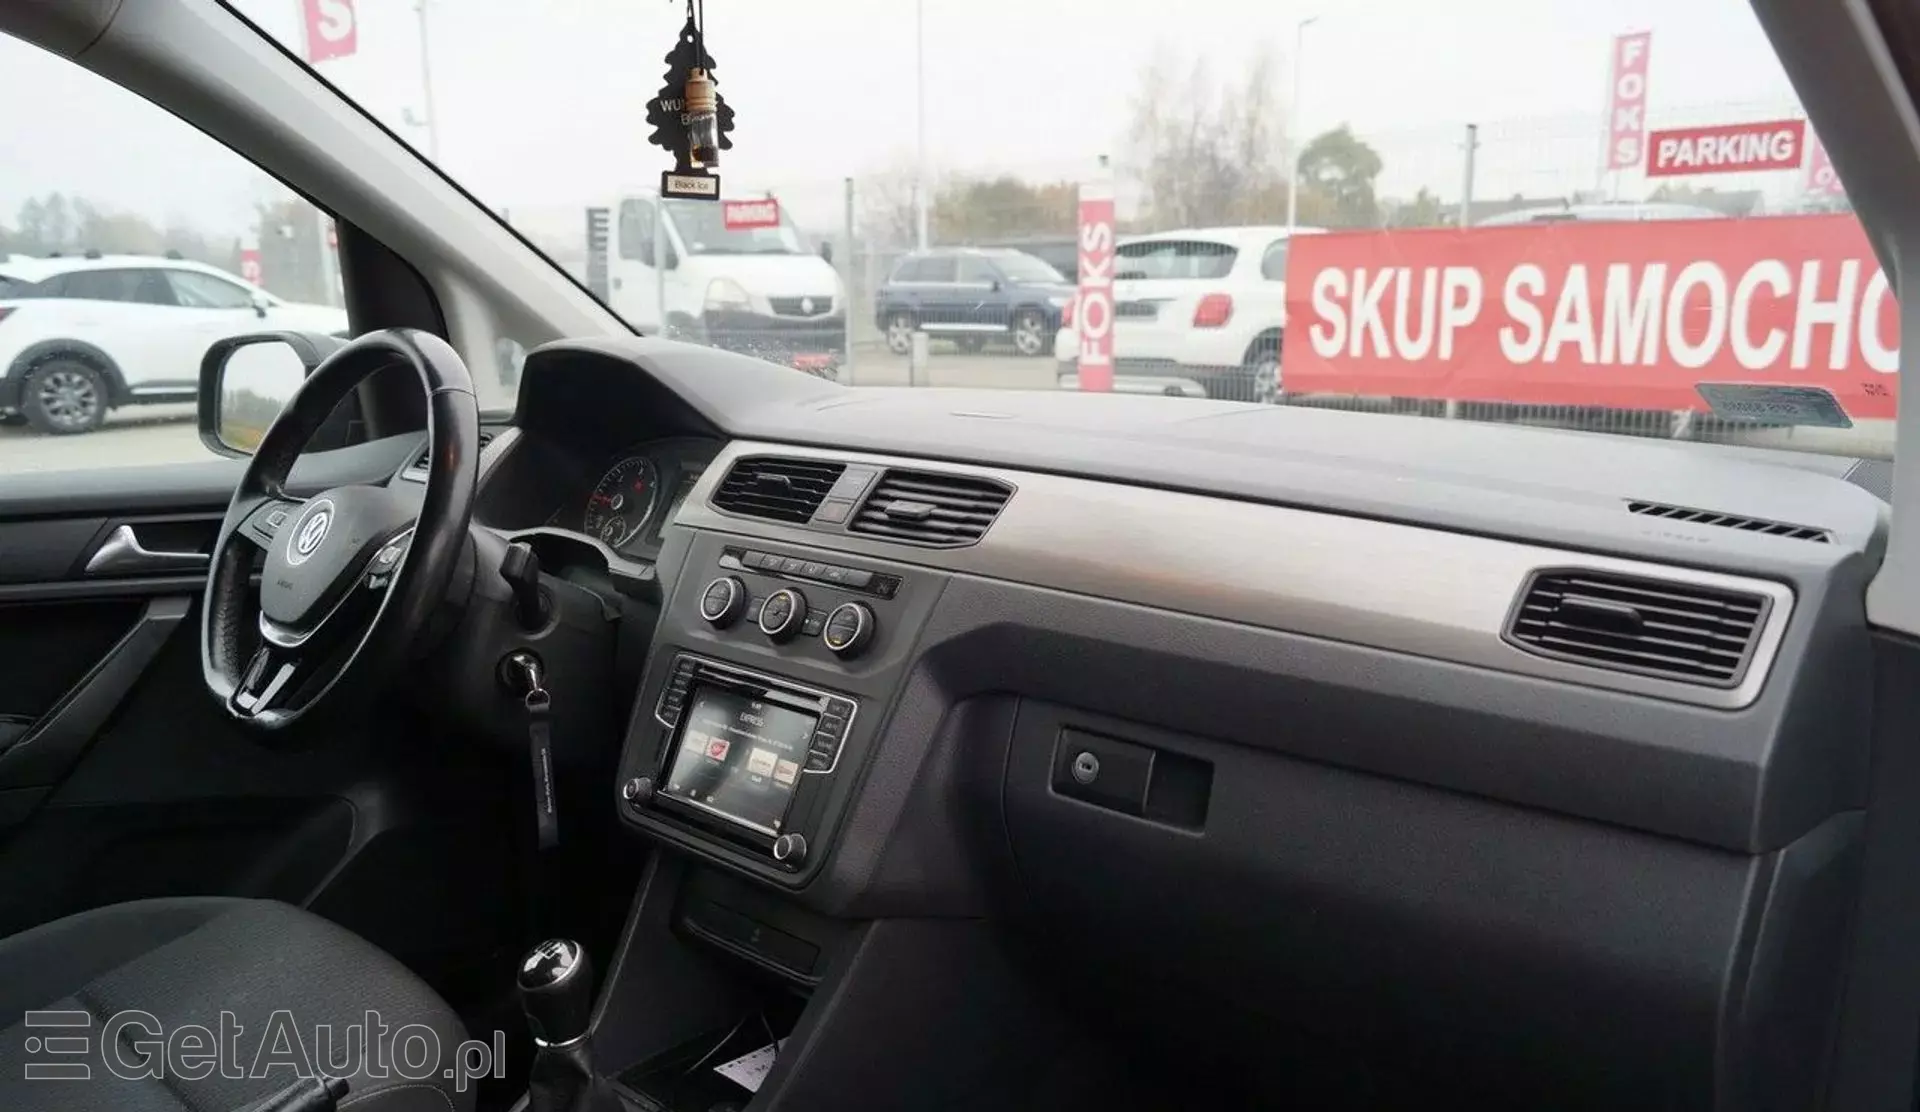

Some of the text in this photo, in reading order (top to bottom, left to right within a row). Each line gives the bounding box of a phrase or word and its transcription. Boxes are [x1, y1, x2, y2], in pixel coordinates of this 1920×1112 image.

[1615, 39, 1644, 165] FOKS
[1656, 130, 1796, 168] PARKING
[1081, 221, 1113, 365] FOKS
[1309, 266, 1483, 361] SKUP
